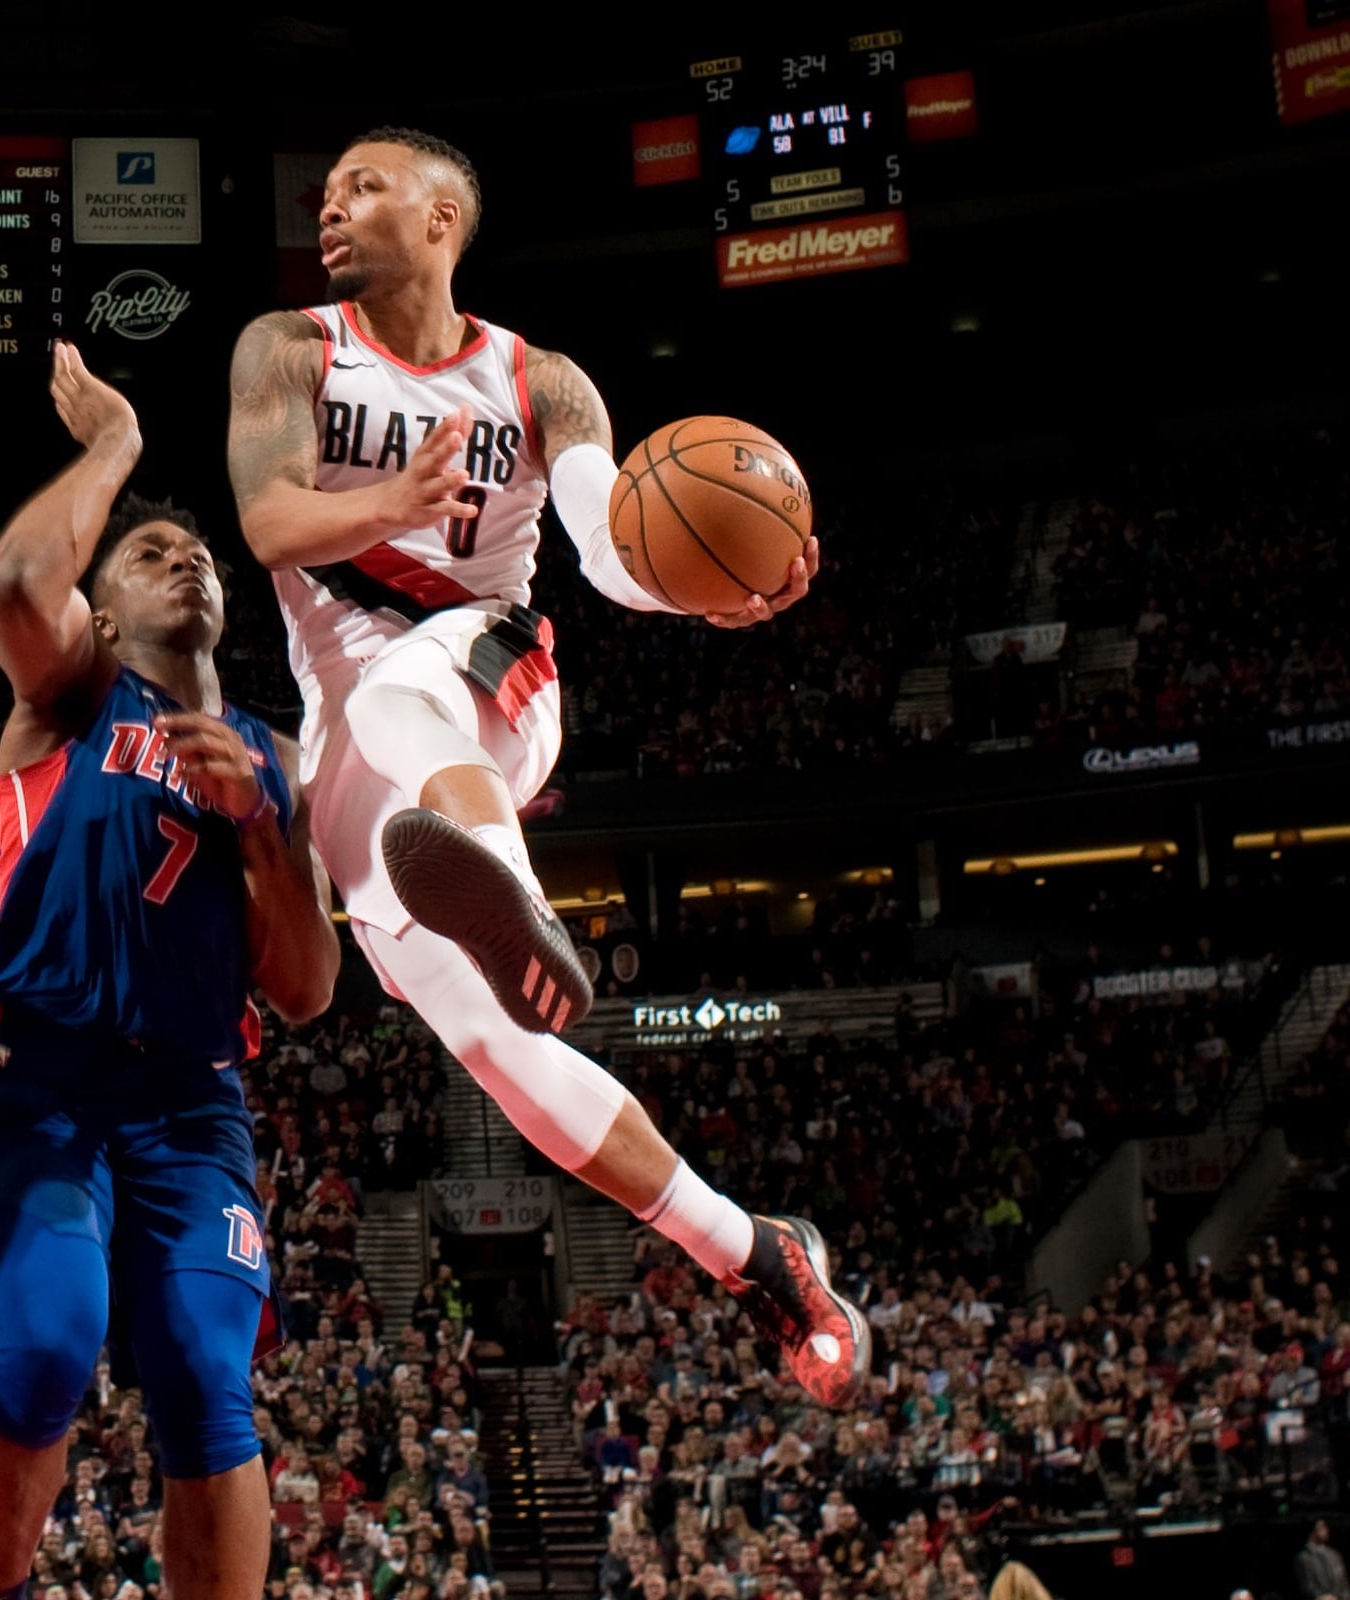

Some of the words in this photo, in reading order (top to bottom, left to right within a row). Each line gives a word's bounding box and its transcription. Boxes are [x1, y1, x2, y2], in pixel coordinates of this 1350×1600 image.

[694, 58, 739, 77] HOME
[782, 55, 826, 81] 3:24
[868, 50, 895, 76] 39
[706, 78, 733, 102] 52
[819, 104, 850, 124] VILL
[15, 165, 61, 178] GUEST
[886, 155, 900, 178] 5
[86, 193, 136, 205] PACIFIC
[141, 193, 187, 205] OFFICE
[727, 180, 740, 202] 5
[51, 212, 61, 228] 9
[89, 207, 185, 218] AUTOMATION
[714, 208, 728, 231] 5
[51, 237, 61, 253] 8
[51, 263, 61, 278] 4
[51, 287, 62, 303] 0
[52, 312, 62, 327] 9
[321, 401, 521, 485] BLARS
[446, 486, 487, 558] 0
[1116, 741, 1200, 762] LEXUS
[142, 811, 199, 906] 7
[634, 1004, 691, 1027] First
[724, 1001, 781, 1023] Tech
[506, 1181, 544, 1198] 210
